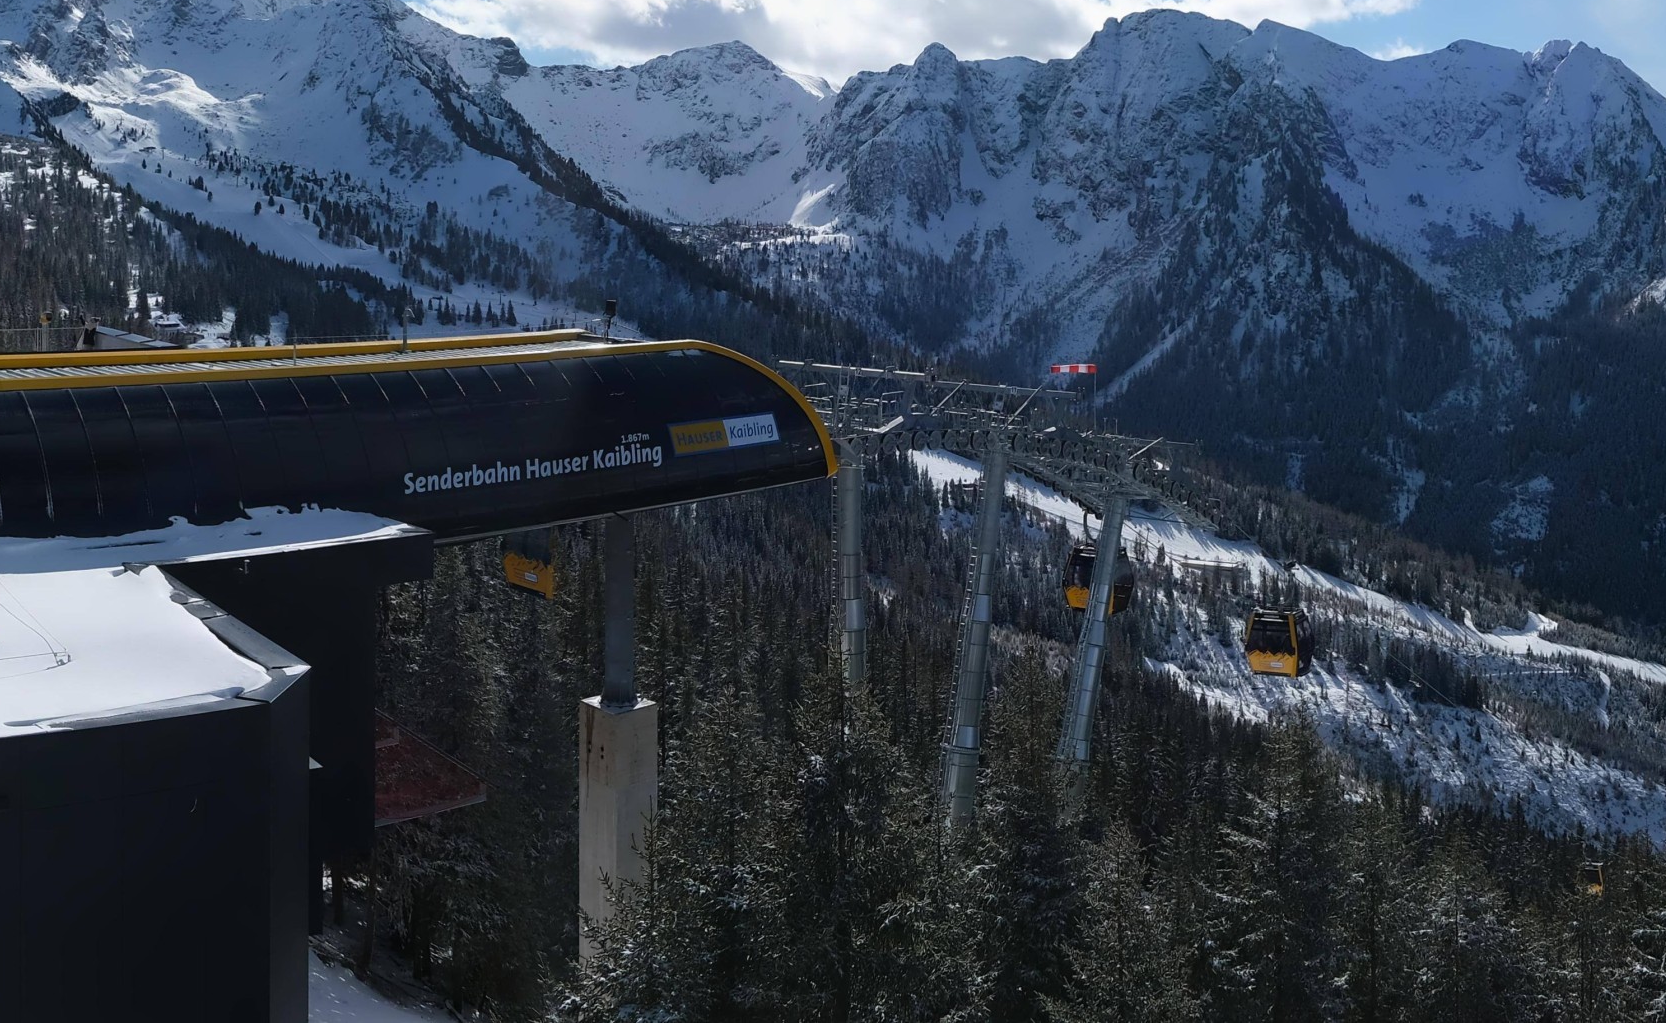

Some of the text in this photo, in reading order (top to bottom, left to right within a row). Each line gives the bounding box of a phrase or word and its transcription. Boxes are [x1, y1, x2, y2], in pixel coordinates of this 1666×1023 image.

[620, 433, 650, 444] 1.867m
[676, 421, 775, 447] HAUSER Kaibling
[404, 442, 663, 495] Senderbahn Hauser Kaibling
